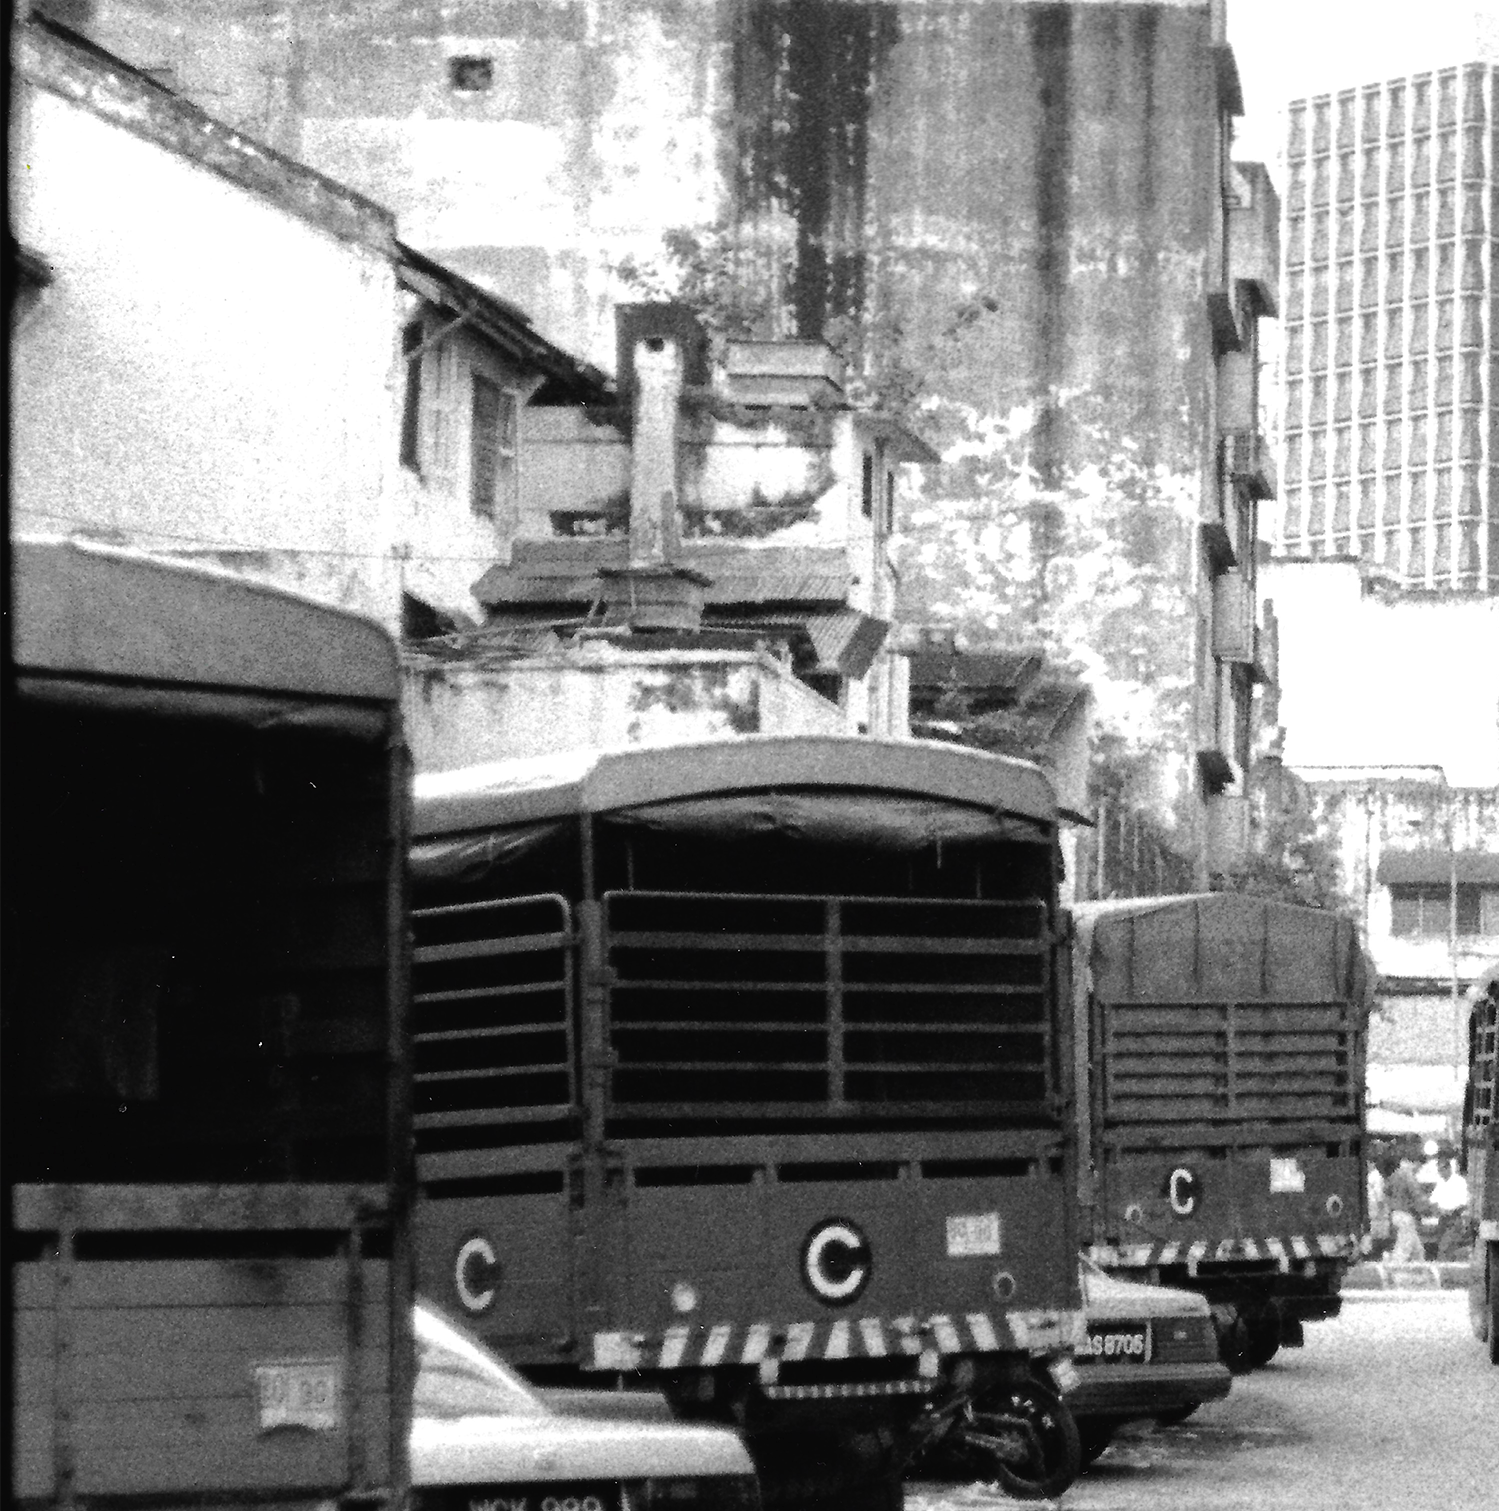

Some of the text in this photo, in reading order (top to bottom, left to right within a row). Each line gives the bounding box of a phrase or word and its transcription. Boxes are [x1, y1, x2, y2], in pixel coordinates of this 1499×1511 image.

[1170, 1168, 1194, 1214] C
[456, 1238, 496, 1310] C
[807, 1226, 863, 1298] C
